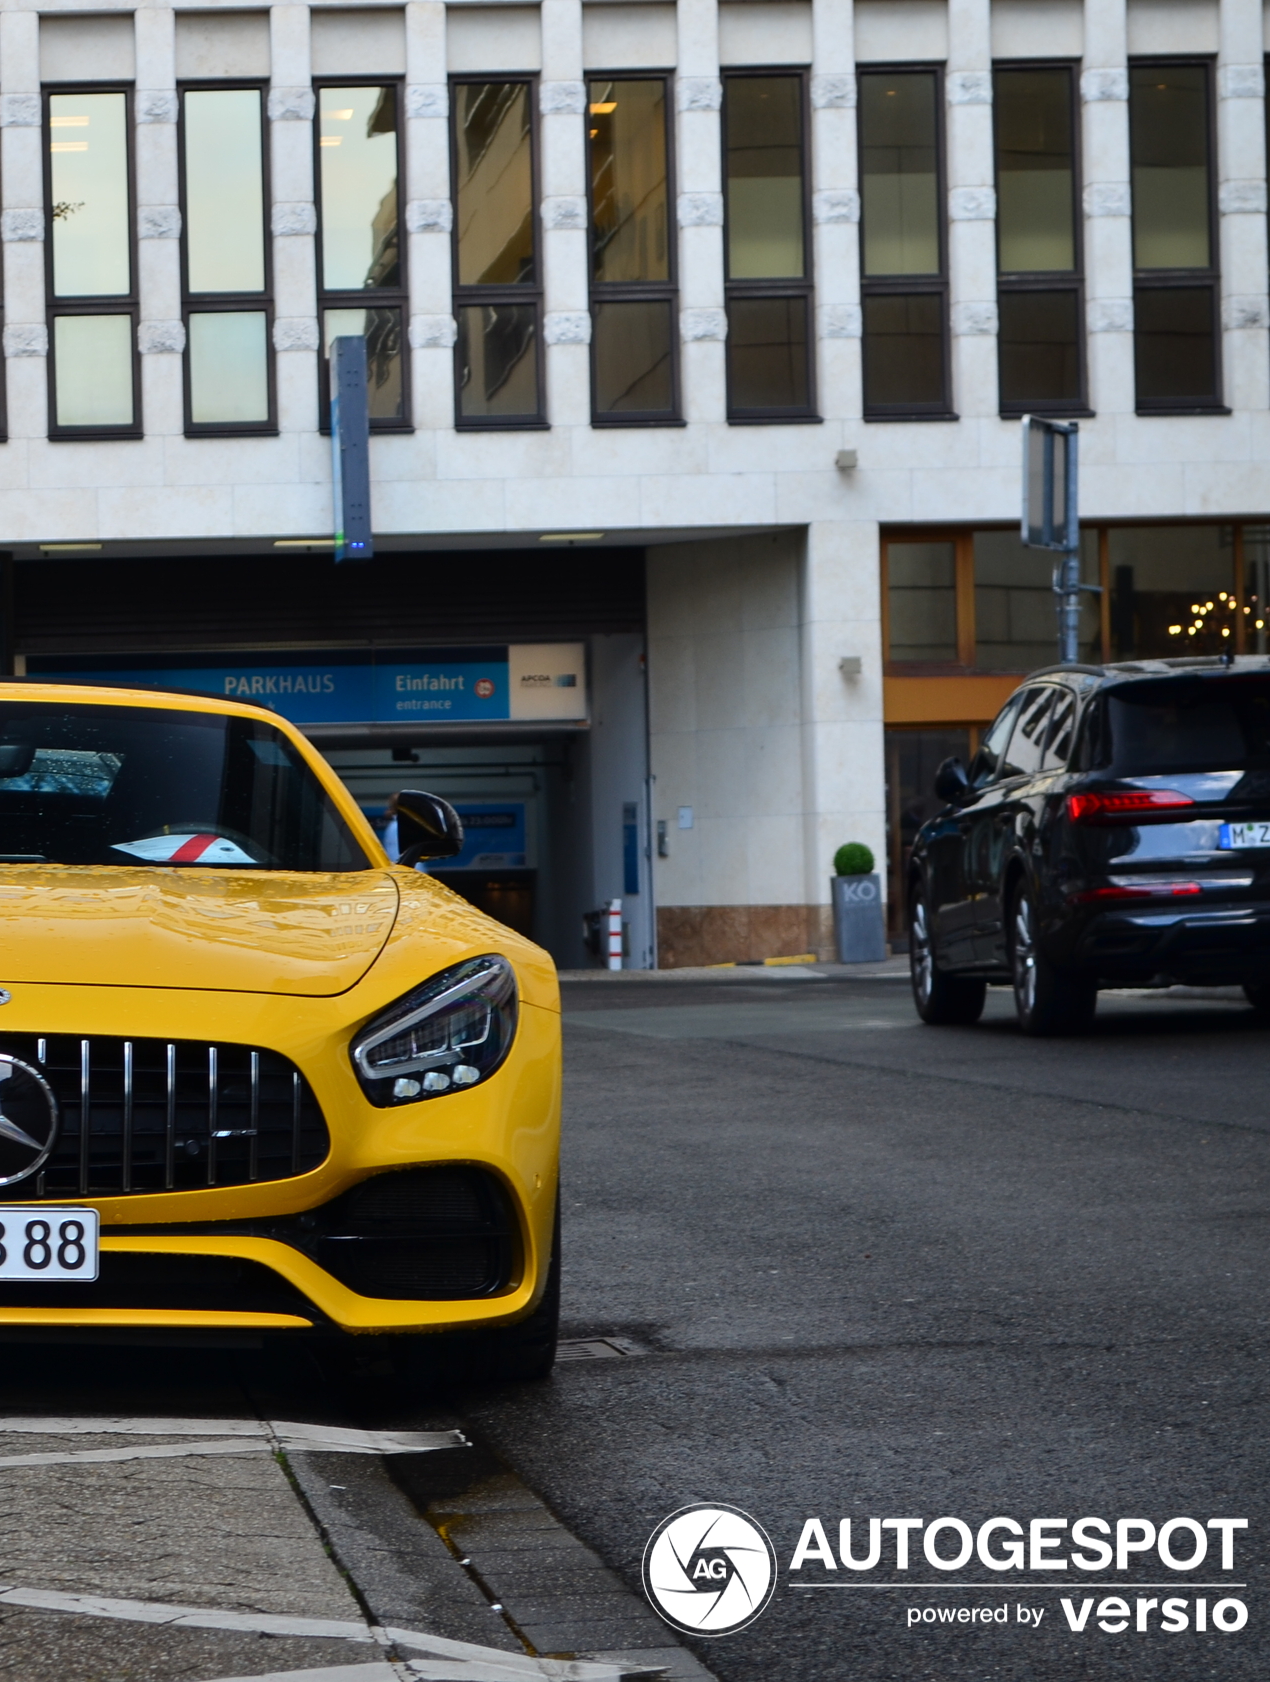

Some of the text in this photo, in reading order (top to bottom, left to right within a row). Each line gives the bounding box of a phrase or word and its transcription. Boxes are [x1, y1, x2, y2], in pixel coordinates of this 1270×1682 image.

[224, 674, 335, 694] PARKHAUS
[395, 674, 465, 692] Einfahrt
[520, 674, 551, 683] APCOA
[395, 699, 452, 710] entrance
[1232, 826, 1245, 844] M
[23, 1219, 86, 1270] 88
